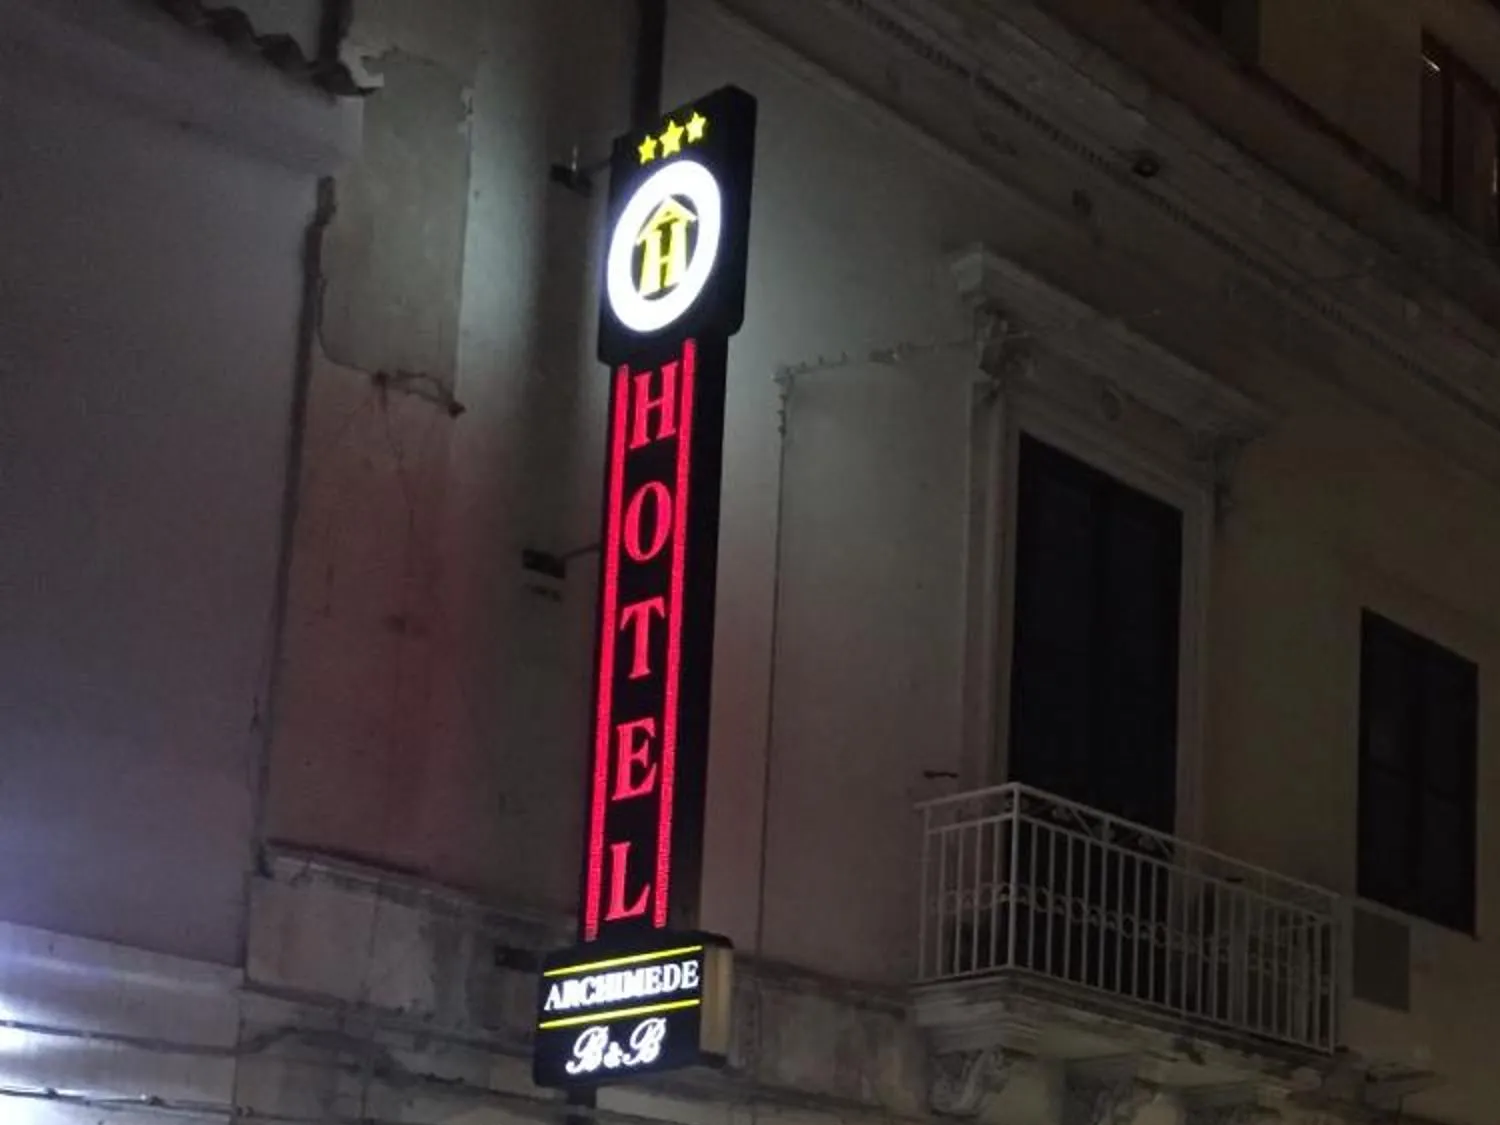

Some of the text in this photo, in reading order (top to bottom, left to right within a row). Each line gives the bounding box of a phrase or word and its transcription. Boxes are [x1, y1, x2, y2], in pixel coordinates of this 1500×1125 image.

[605, 360, 680, 922] HOTEL
[544, 960, 700, 1011] ARCHIMEDE
[565, 1017, 667, 1075] B&B
